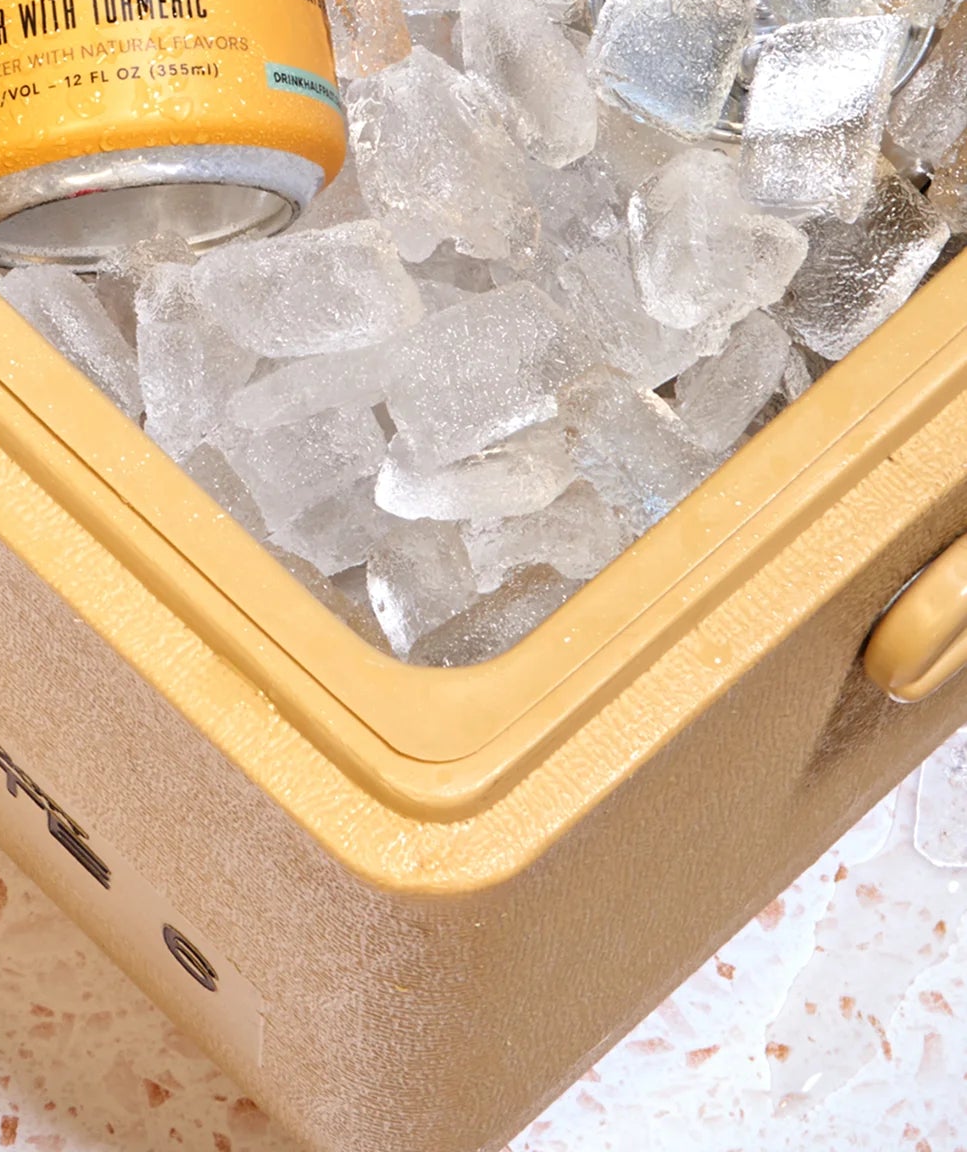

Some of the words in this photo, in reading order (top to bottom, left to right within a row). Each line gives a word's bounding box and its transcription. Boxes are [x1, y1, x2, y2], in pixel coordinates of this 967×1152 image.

[27, 47, 75, 70] WITH
[80, 35, 168, 60] NATURAL
[172, 34, 250, 52] FLAVORS
[64, 73, 83, 88] 12
[90, 71, 110, 84] FL
[117, 66, 142, 81] OZ
[149, 62, 220, 81] (355ml)
